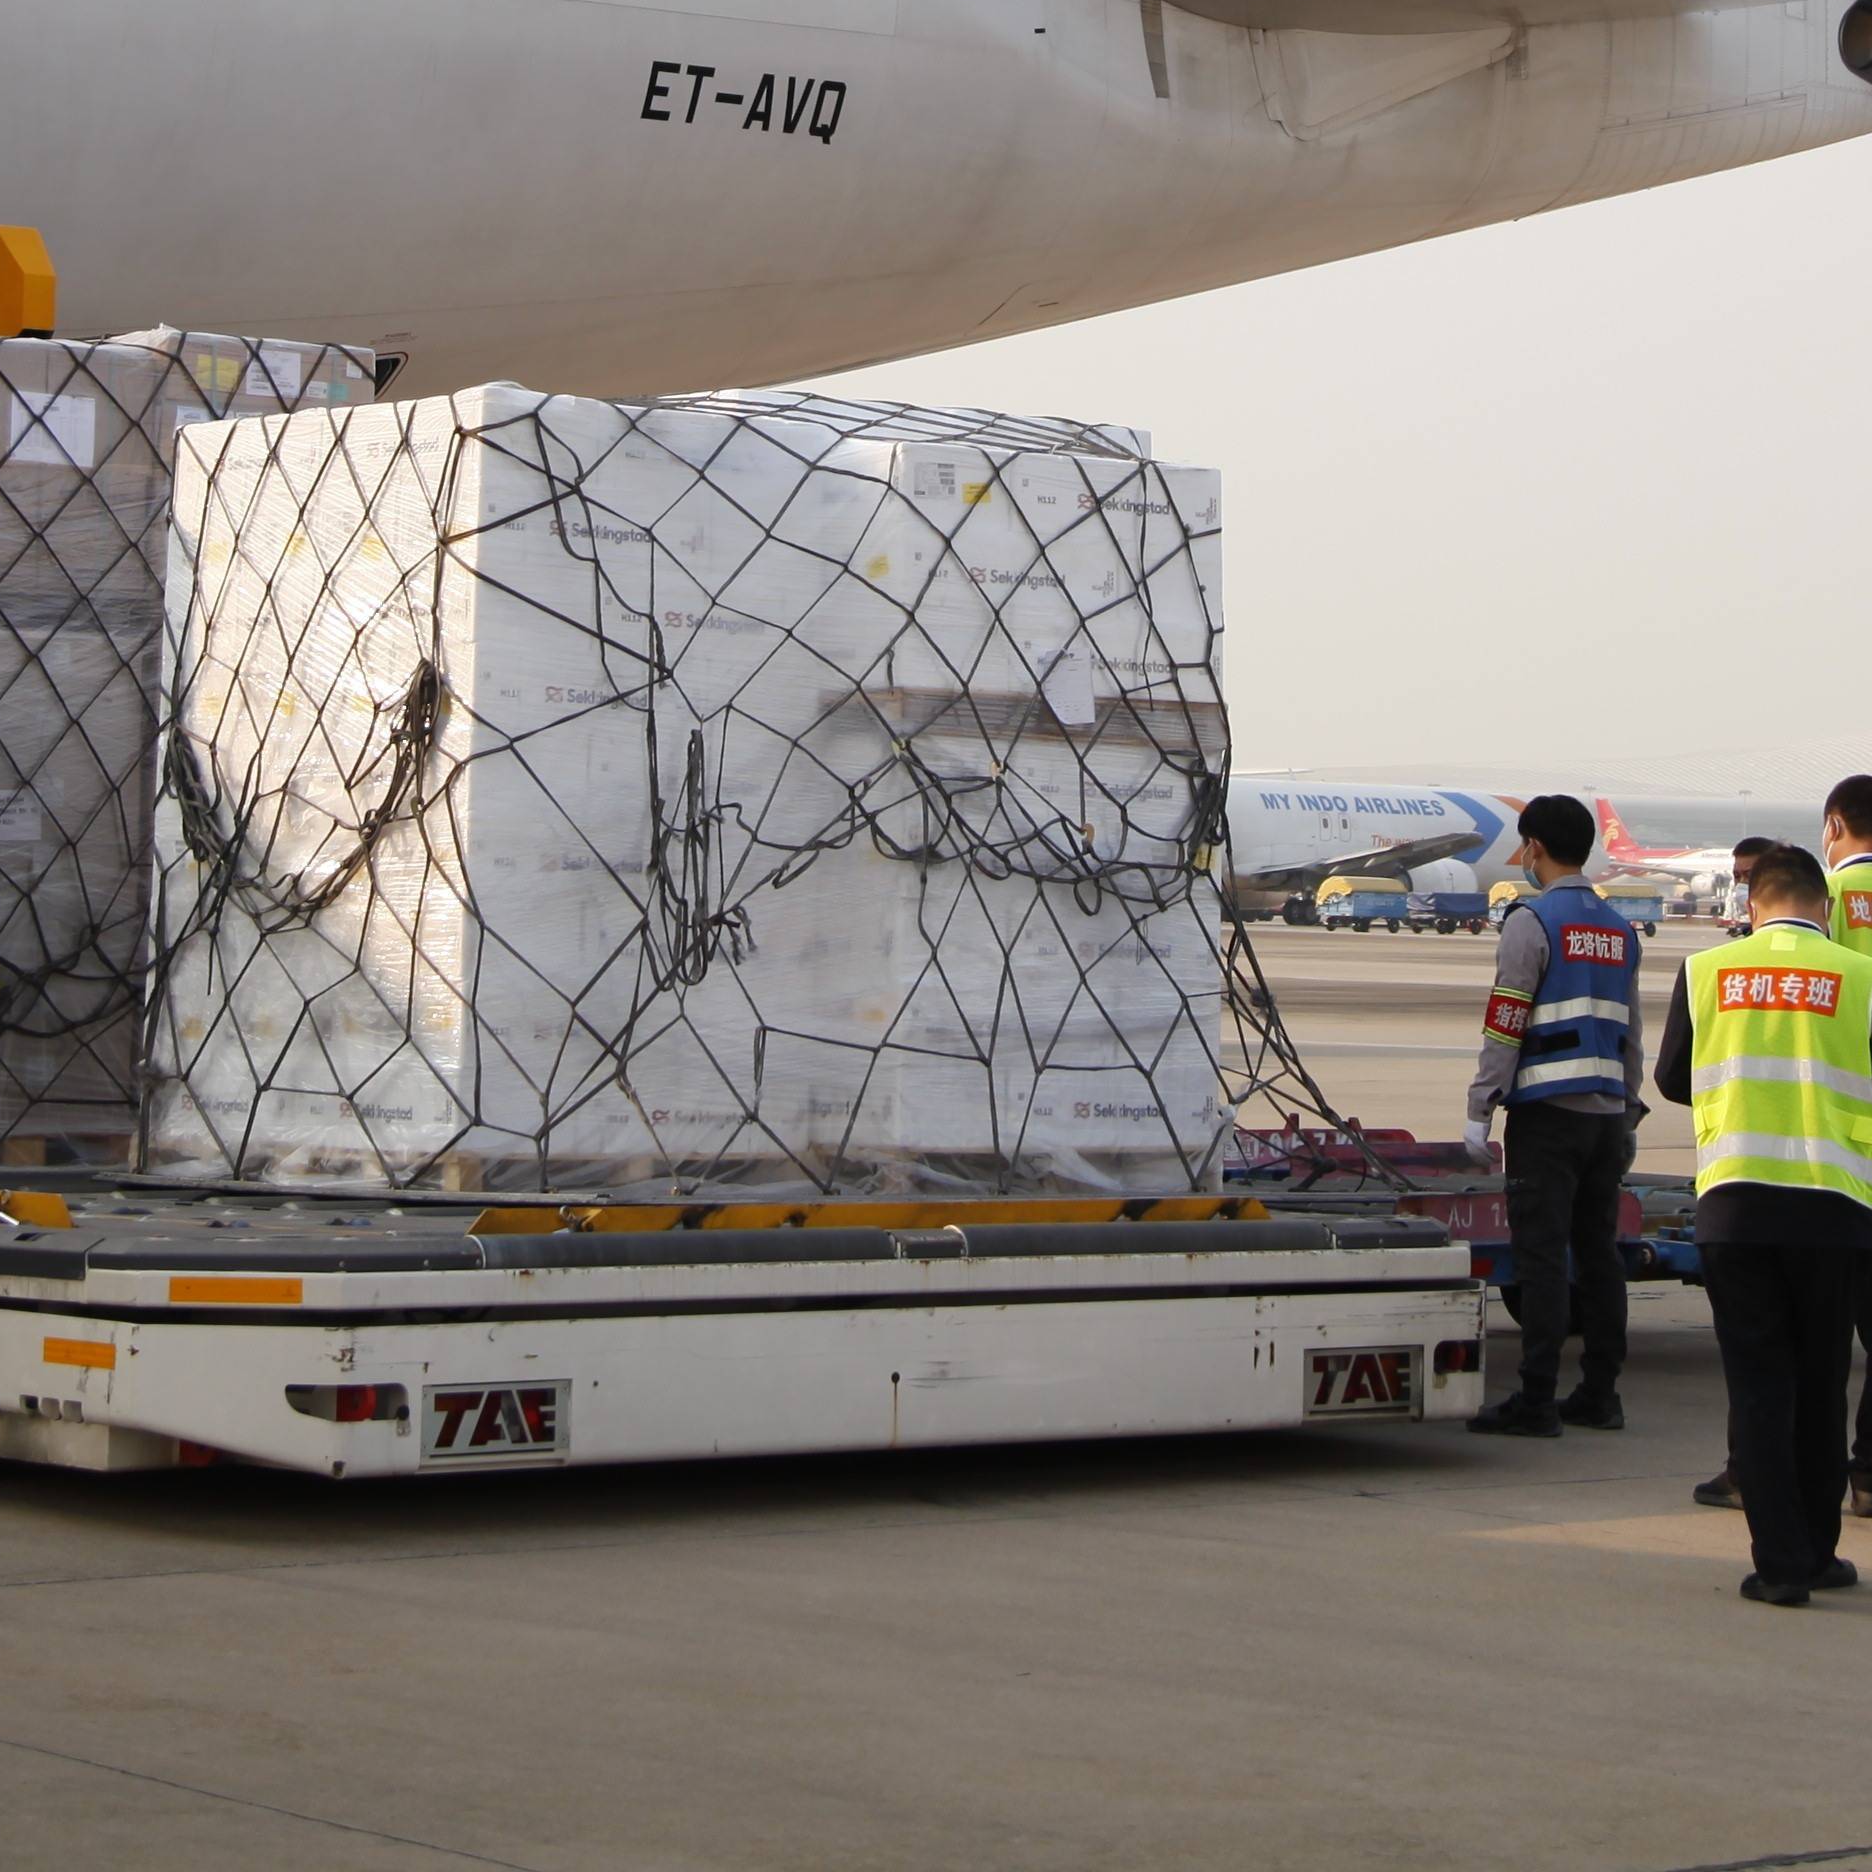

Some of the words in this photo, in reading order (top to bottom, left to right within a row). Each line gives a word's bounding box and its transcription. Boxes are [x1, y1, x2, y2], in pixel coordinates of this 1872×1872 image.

[640, 59, 848, 146] ET-AVQ
[1259, 792, 1291, 811] MY
[1295, 794, 1349, 813] INDO
[1354, 796, 1446, 817] AIRLINES
[1370, 834, 1393, 848] The
[1723, 972, 1836, 1008] 货机专班
[1311, 1351, 1411, 1408] TAE
[433, 1387, 557, 1449] TAE
